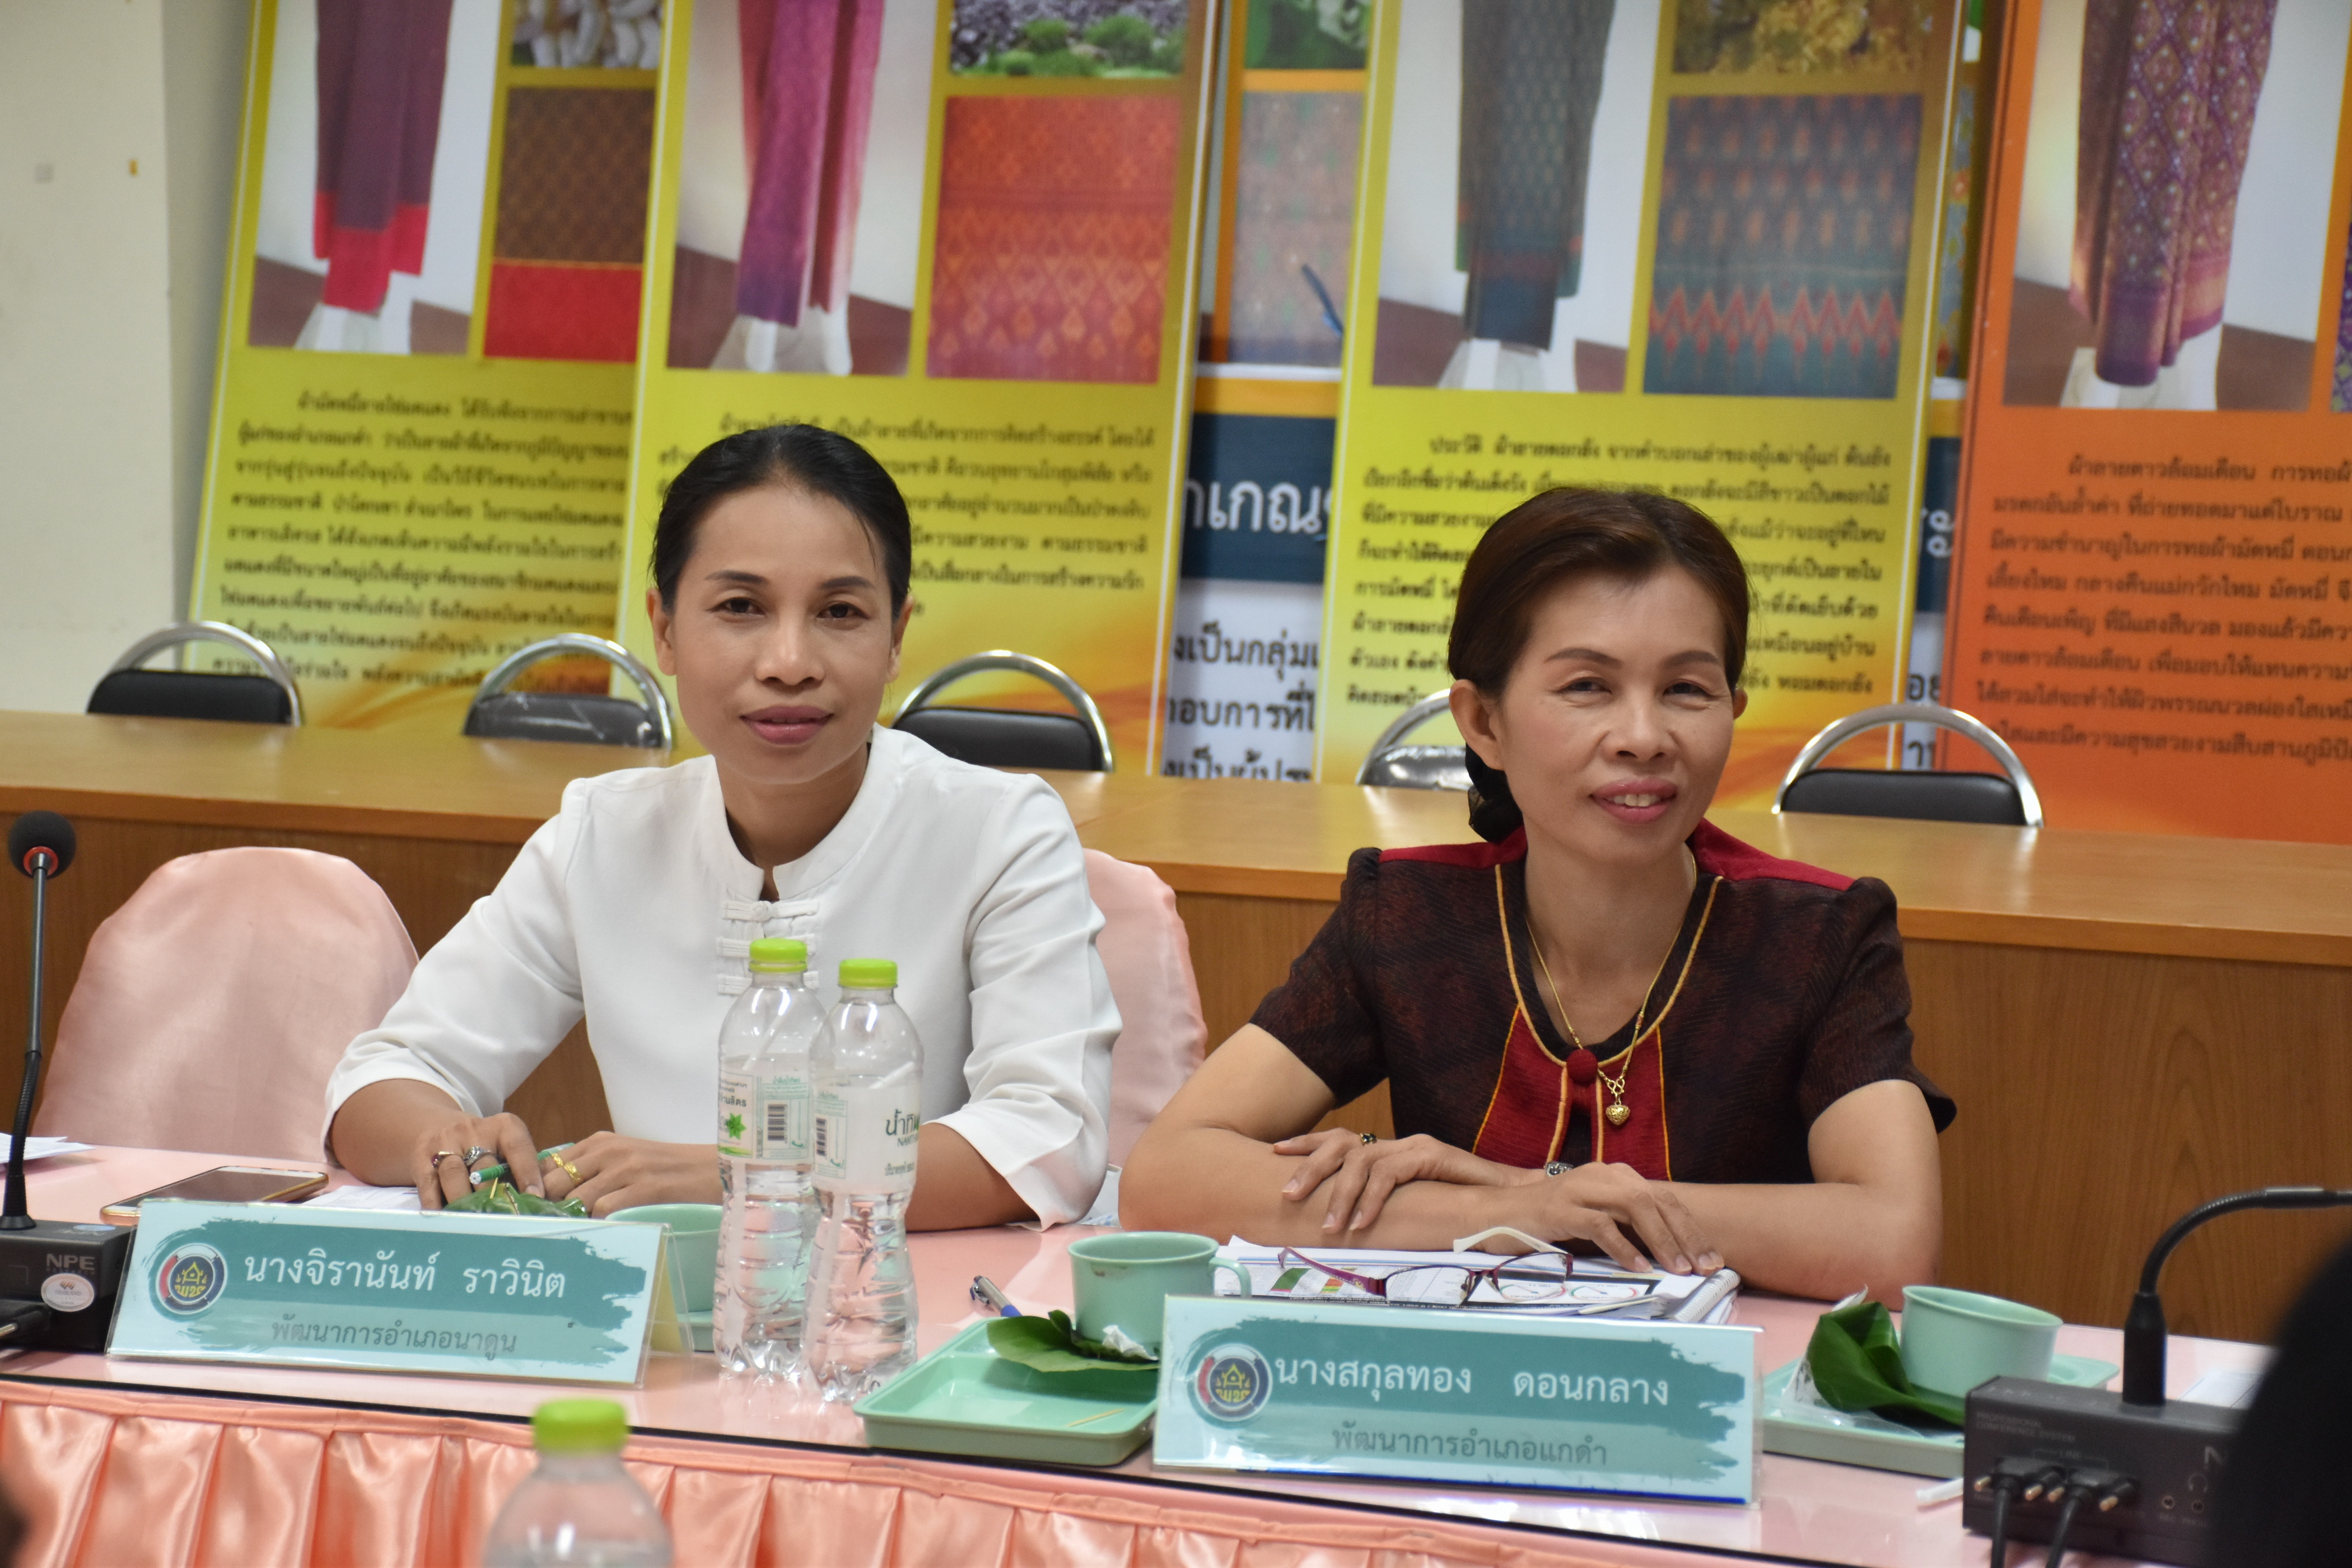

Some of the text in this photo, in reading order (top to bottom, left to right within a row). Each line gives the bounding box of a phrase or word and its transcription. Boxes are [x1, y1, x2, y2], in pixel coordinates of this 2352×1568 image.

[46, 1253, 95, 1271] NPE
[244, 1247, 566, 1298] นางจิรานันท์ ราวินิต
[272, 1313, 516, 1361] พัฒนาการอำเภอนาดูน
[1275, 1358, 1669, 1406] นางสกุลทอง ดอนกลาง
[1332, 1420, 1607, 1466] พัฒนาการอำเภอแกดำ
